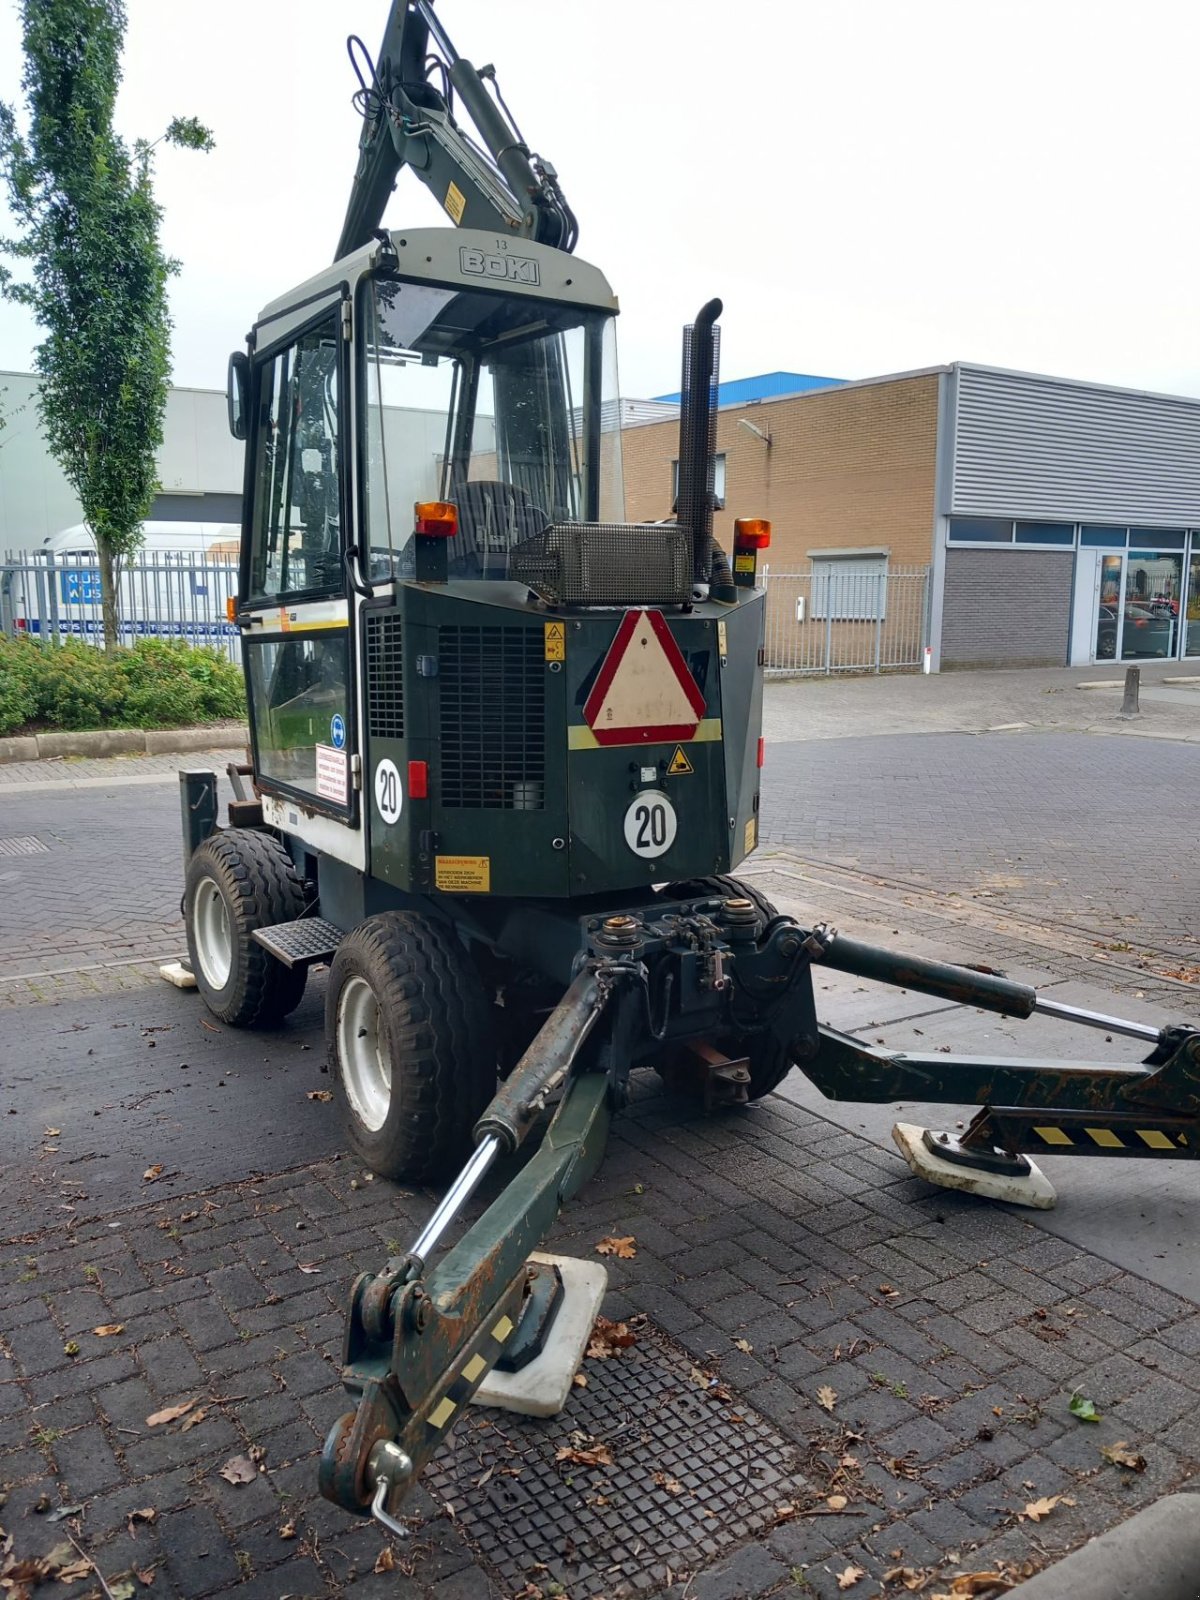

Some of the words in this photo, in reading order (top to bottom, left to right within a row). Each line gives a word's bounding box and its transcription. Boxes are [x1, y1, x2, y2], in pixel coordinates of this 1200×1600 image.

[495, 239, 508, 250] 13
[380, 769, 396, 814] 20
[635, 804, 667, 848] 20
